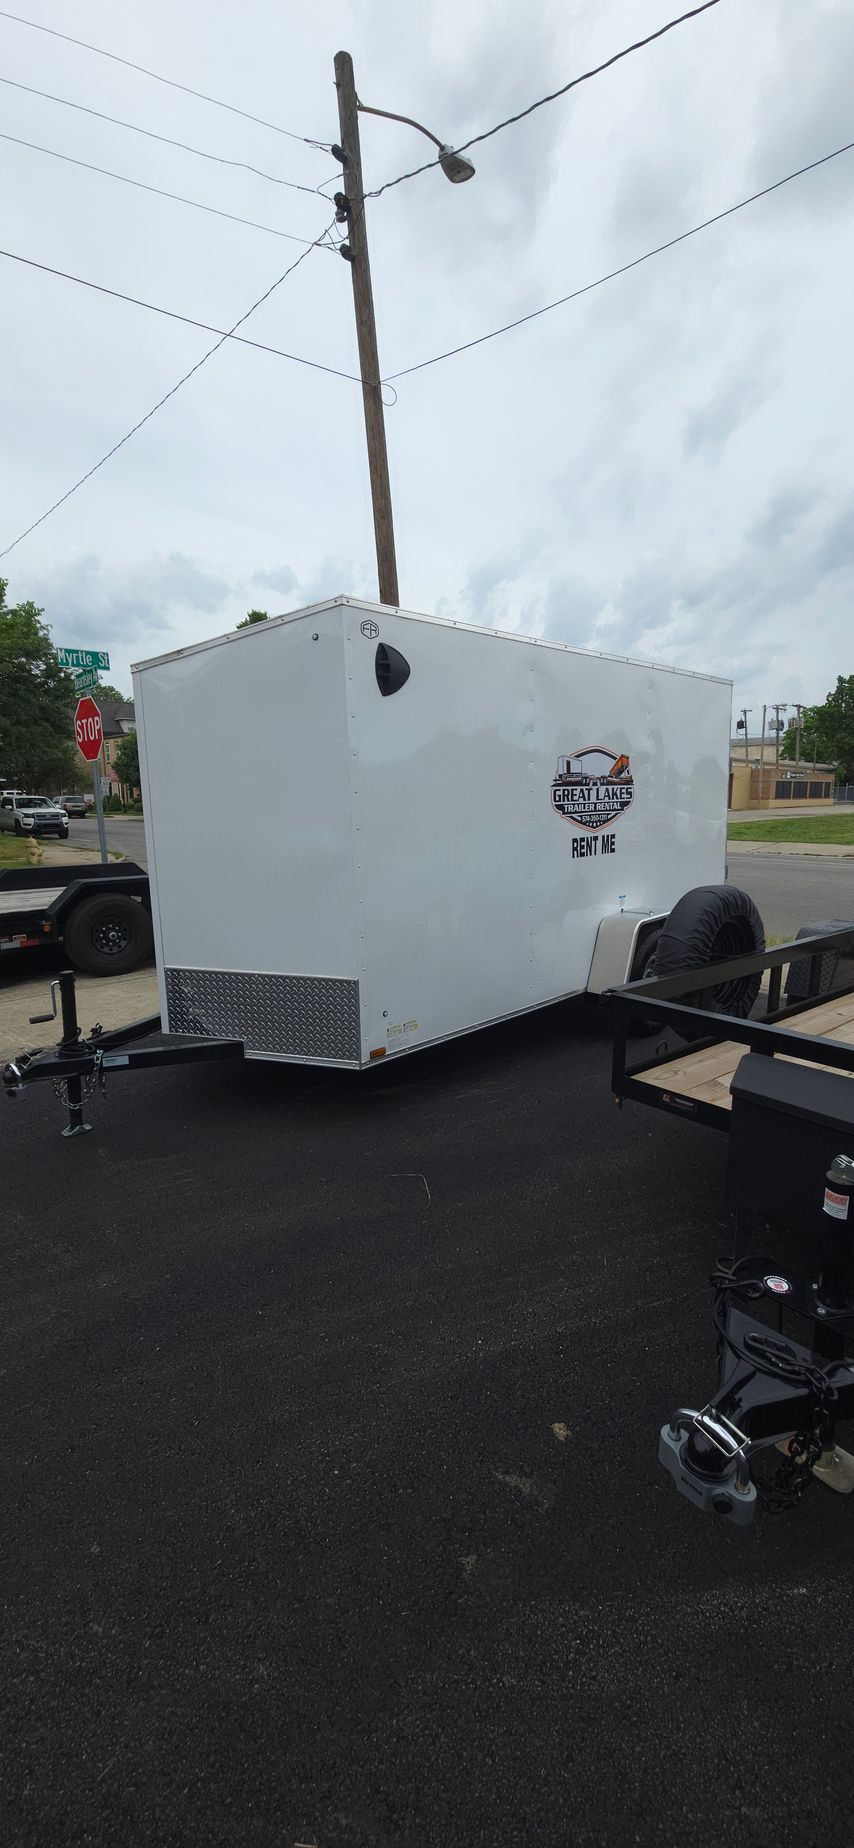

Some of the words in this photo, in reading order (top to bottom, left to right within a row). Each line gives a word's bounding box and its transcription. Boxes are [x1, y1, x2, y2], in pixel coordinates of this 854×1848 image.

[57, 648, 92, 666] Myrtle
[98, 653, 109, 667] St
[76, 716, 101, 743] STOP
[553, 787, 593, 803] GREAT
[596, 787, 633, 801] LAKES
[564, 803, 595, 813] TRAILER
[596, 802, 621, 811] RENTAL
[572, 836, 599, 858] RENT
[602, 834, 616, 854] ME
